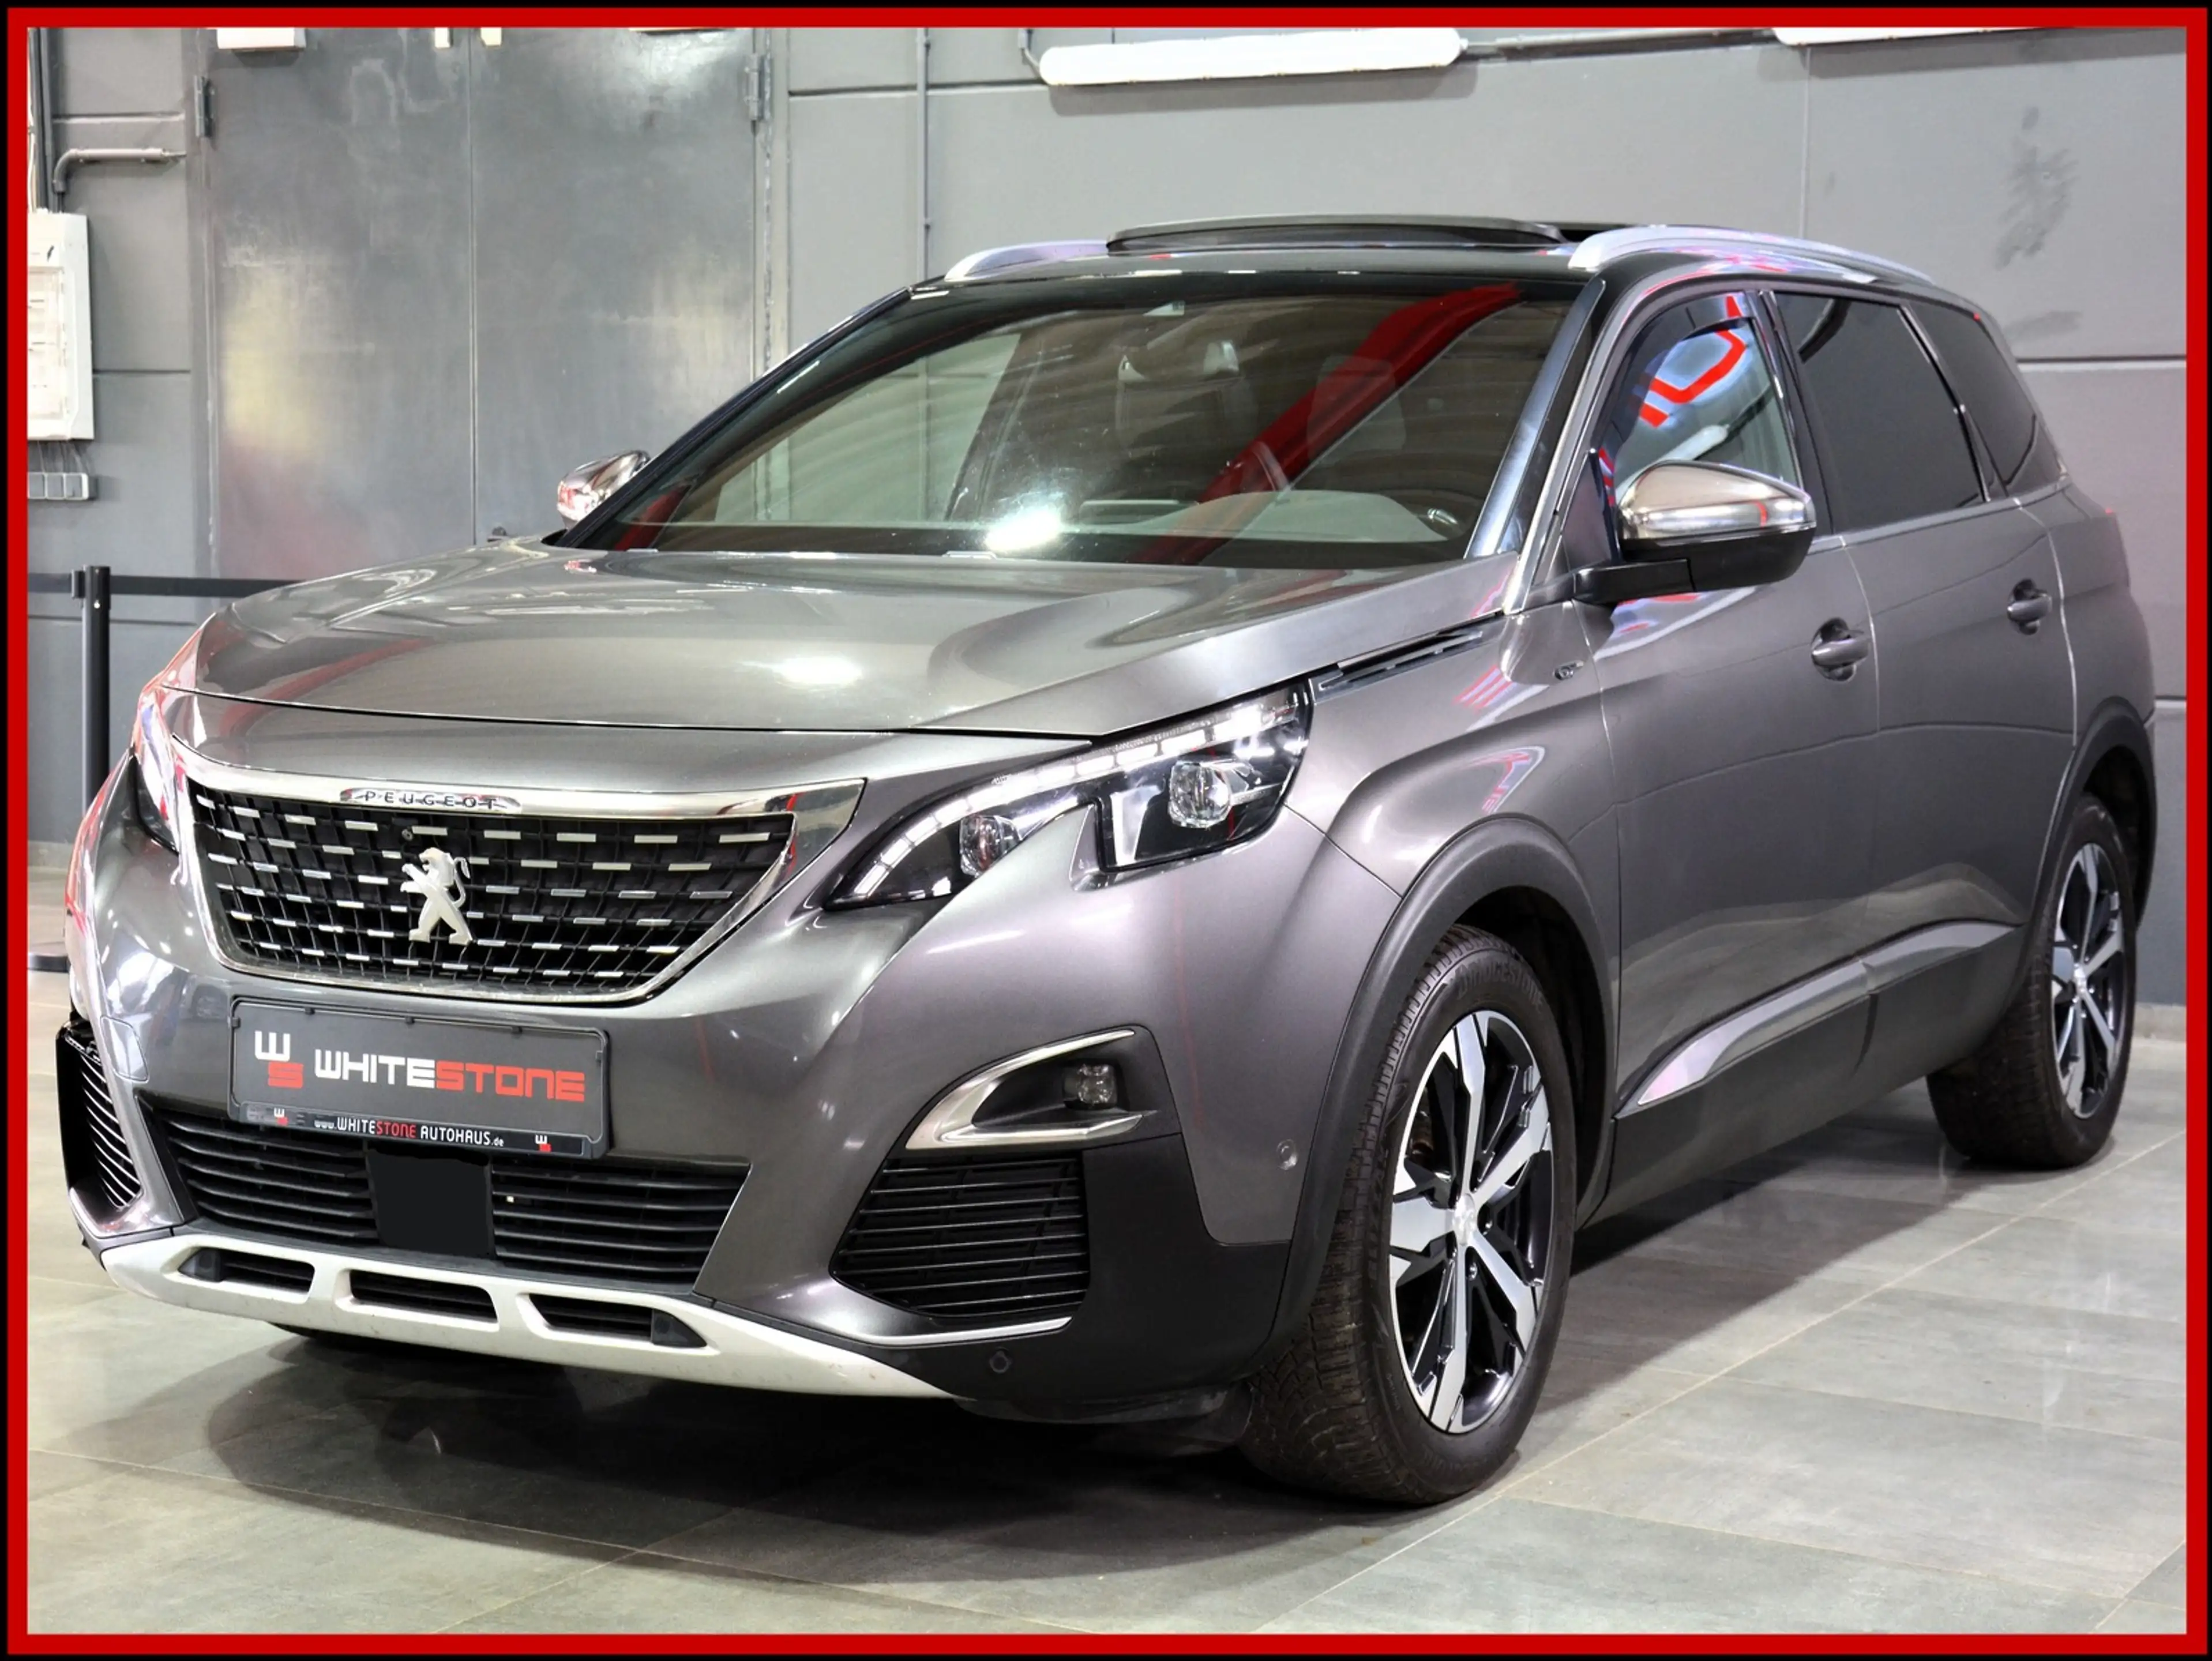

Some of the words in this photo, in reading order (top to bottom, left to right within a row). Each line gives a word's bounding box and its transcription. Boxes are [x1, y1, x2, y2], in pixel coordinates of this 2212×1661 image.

[365, 791, 497, 809] PEUGEOT
[314, 1048, 585, 1102] WHITESTONE
[420, 1125, 504, 1147] AUTOHAUS.de
